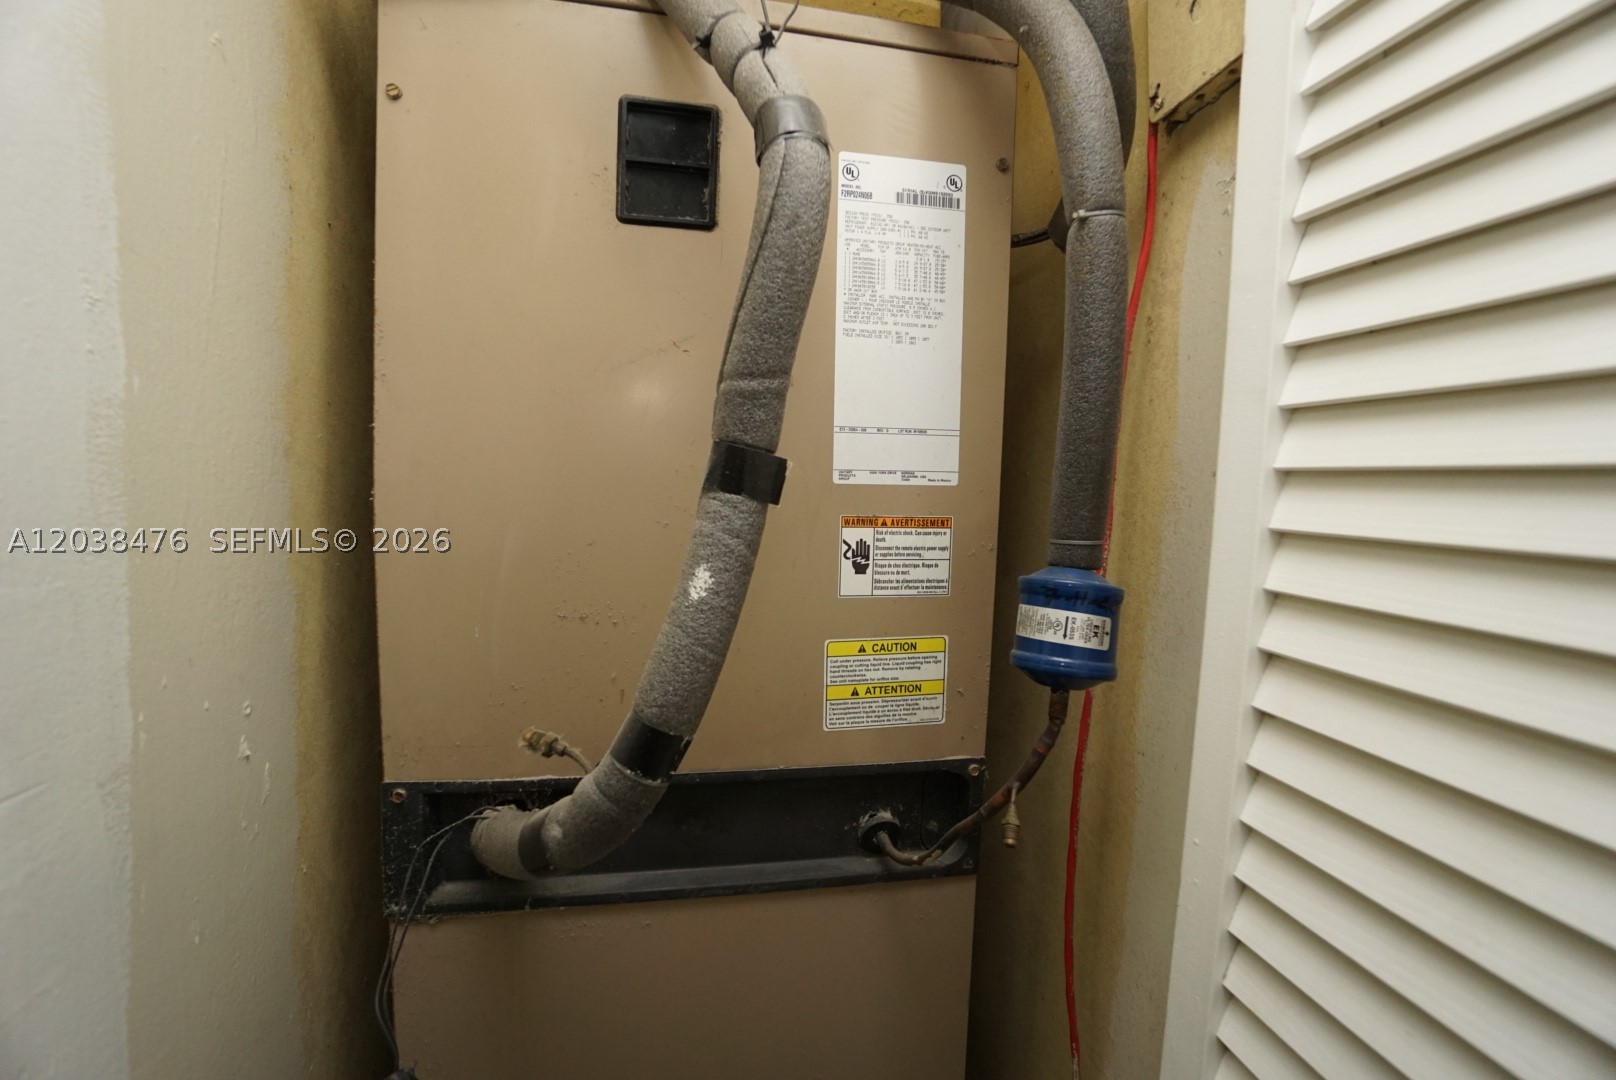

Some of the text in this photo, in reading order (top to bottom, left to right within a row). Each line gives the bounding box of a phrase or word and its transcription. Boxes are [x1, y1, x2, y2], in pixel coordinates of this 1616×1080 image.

[843, 518, 950, 527] WARNING AVERTISSEMENT
[1092, 624, 1100, 639] EK
[872, 642, 917, 653] CAUTION
[864, 684, 922, 695] ATTENTION
